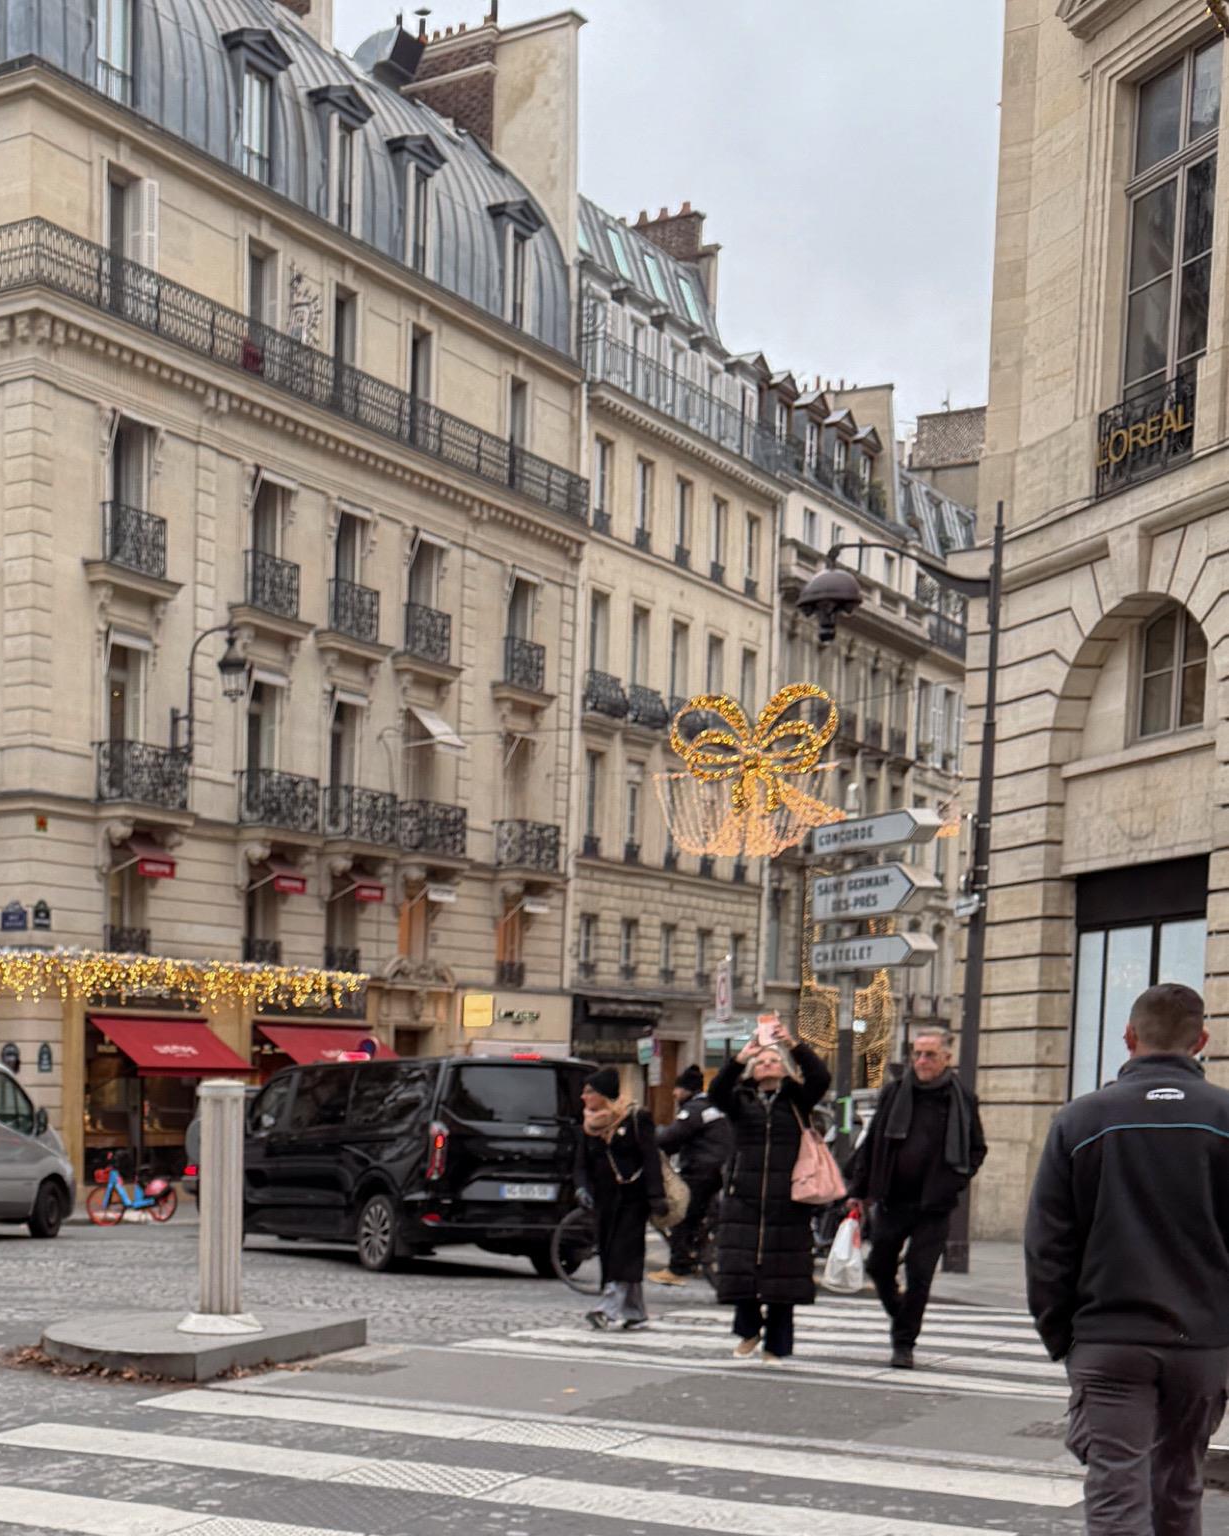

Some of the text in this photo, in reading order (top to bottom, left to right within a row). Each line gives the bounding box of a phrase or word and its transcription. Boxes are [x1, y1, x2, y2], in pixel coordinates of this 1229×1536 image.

[818, 825, 874, 846] CONCORDE
[817, 881, 843, 896] SAINT
[831, 893, 878, 912] DES-PRÉS
[815, 945, 872, 964] CHÂTELET
